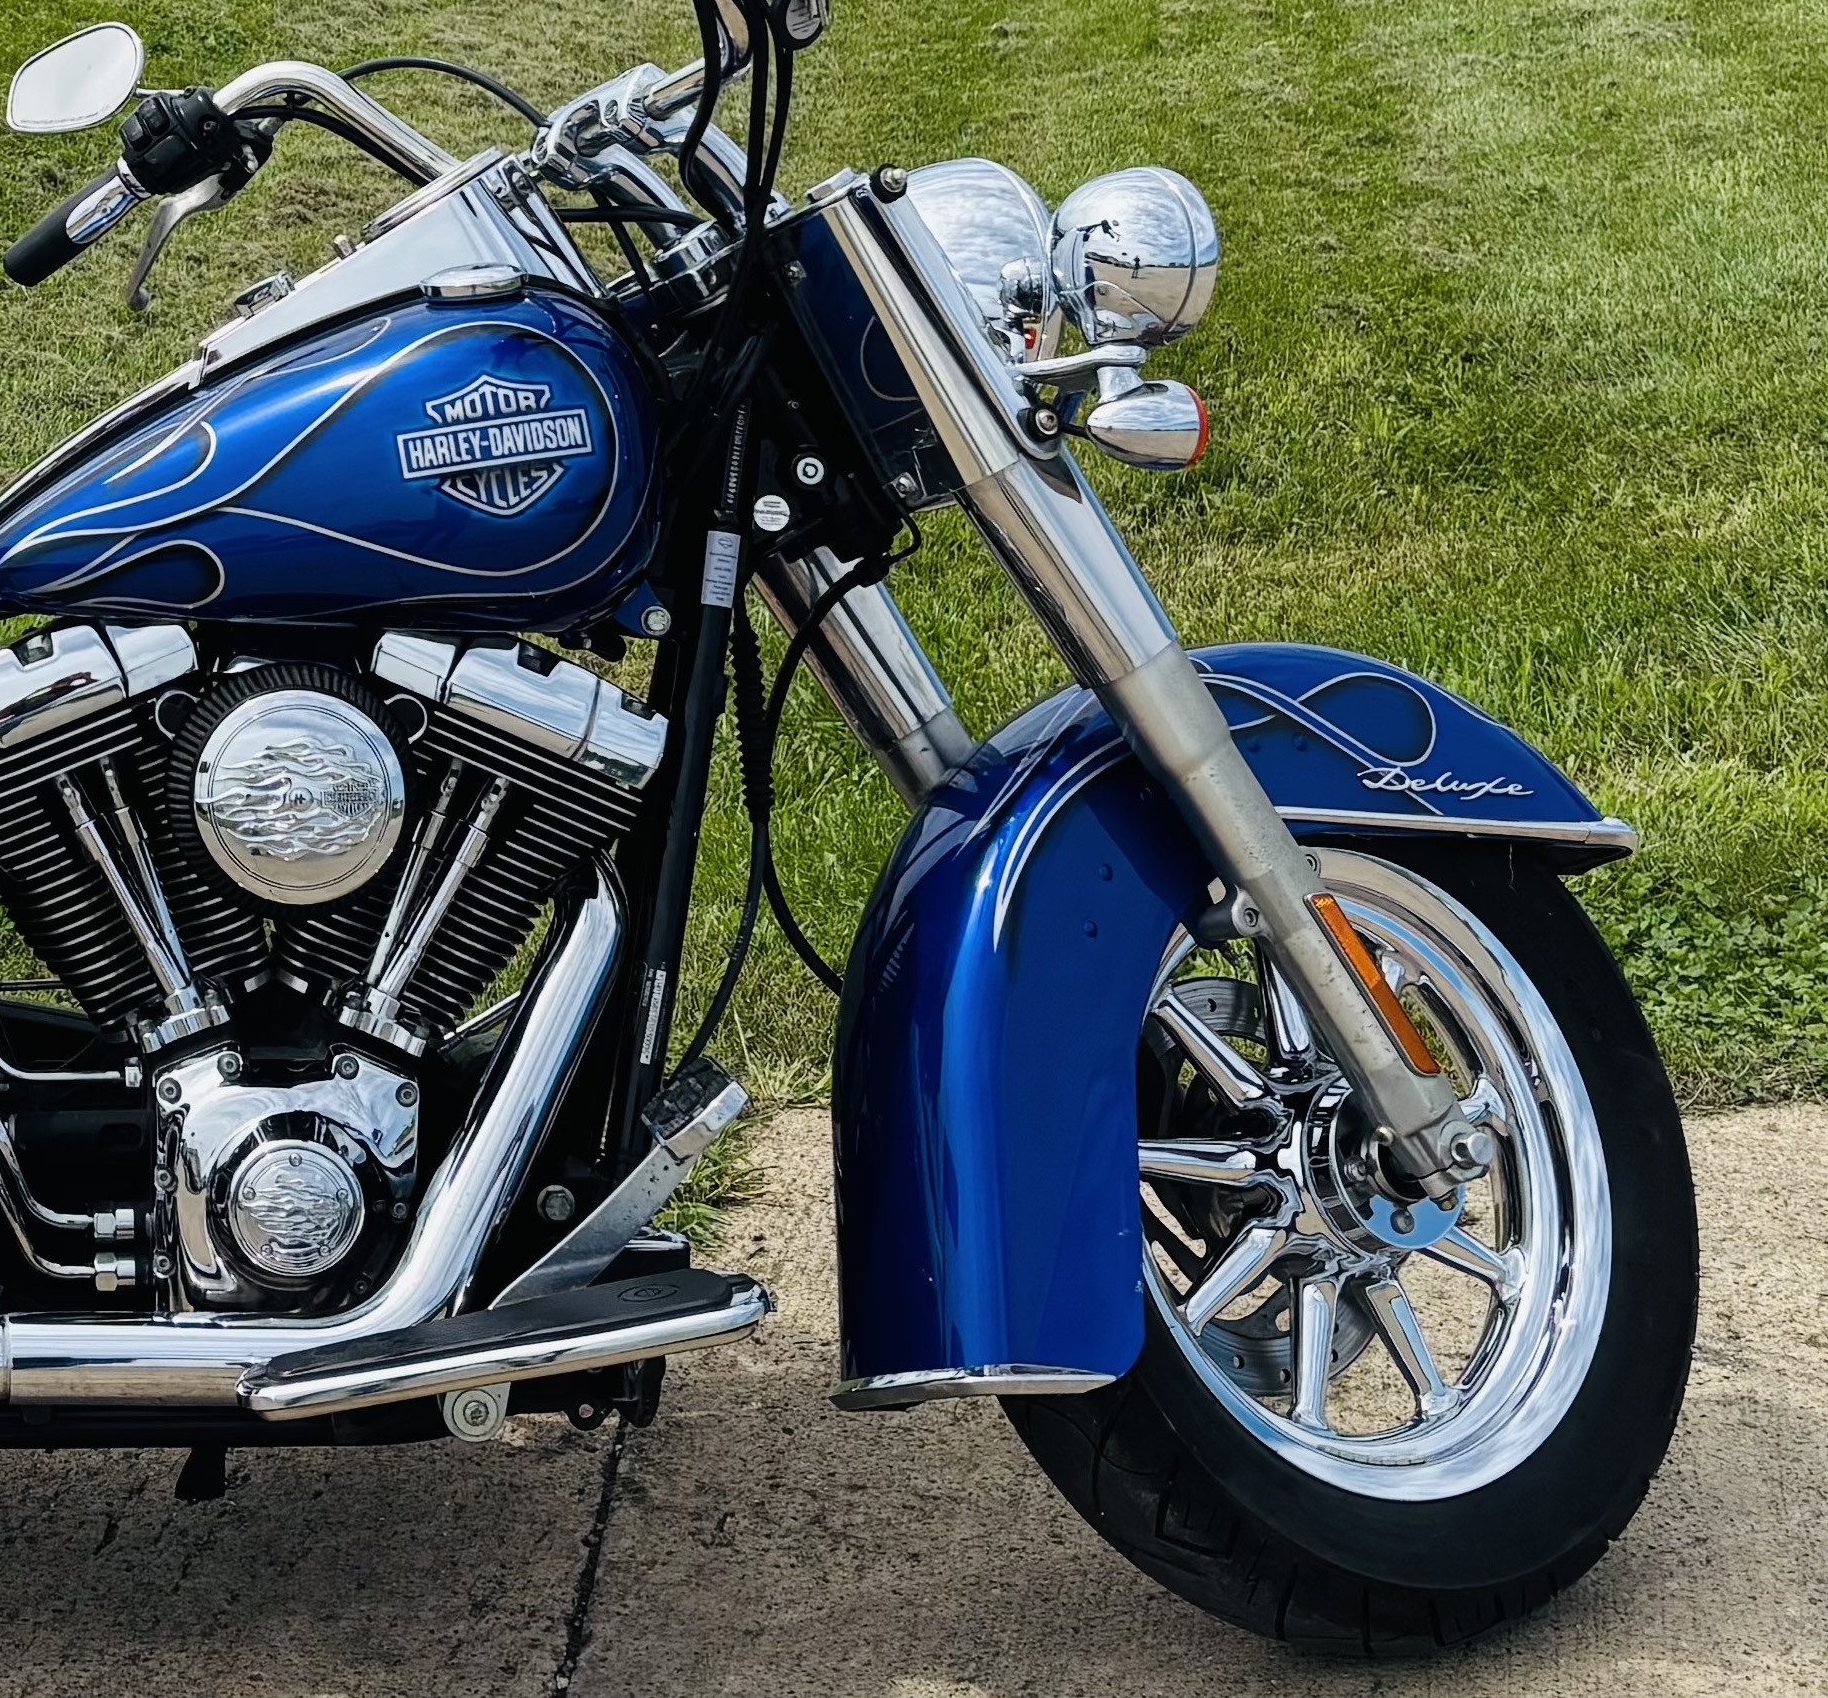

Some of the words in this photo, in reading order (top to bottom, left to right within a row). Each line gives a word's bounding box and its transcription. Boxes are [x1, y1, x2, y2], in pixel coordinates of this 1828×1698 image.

[443, 383, 537, 423] MOTOR
[408, 416, 583, 470] HARLEY-DAVIDSON
[456, 463, 549, 508] CYCLES
[1356, 767, 1535, 800] Deluxe
